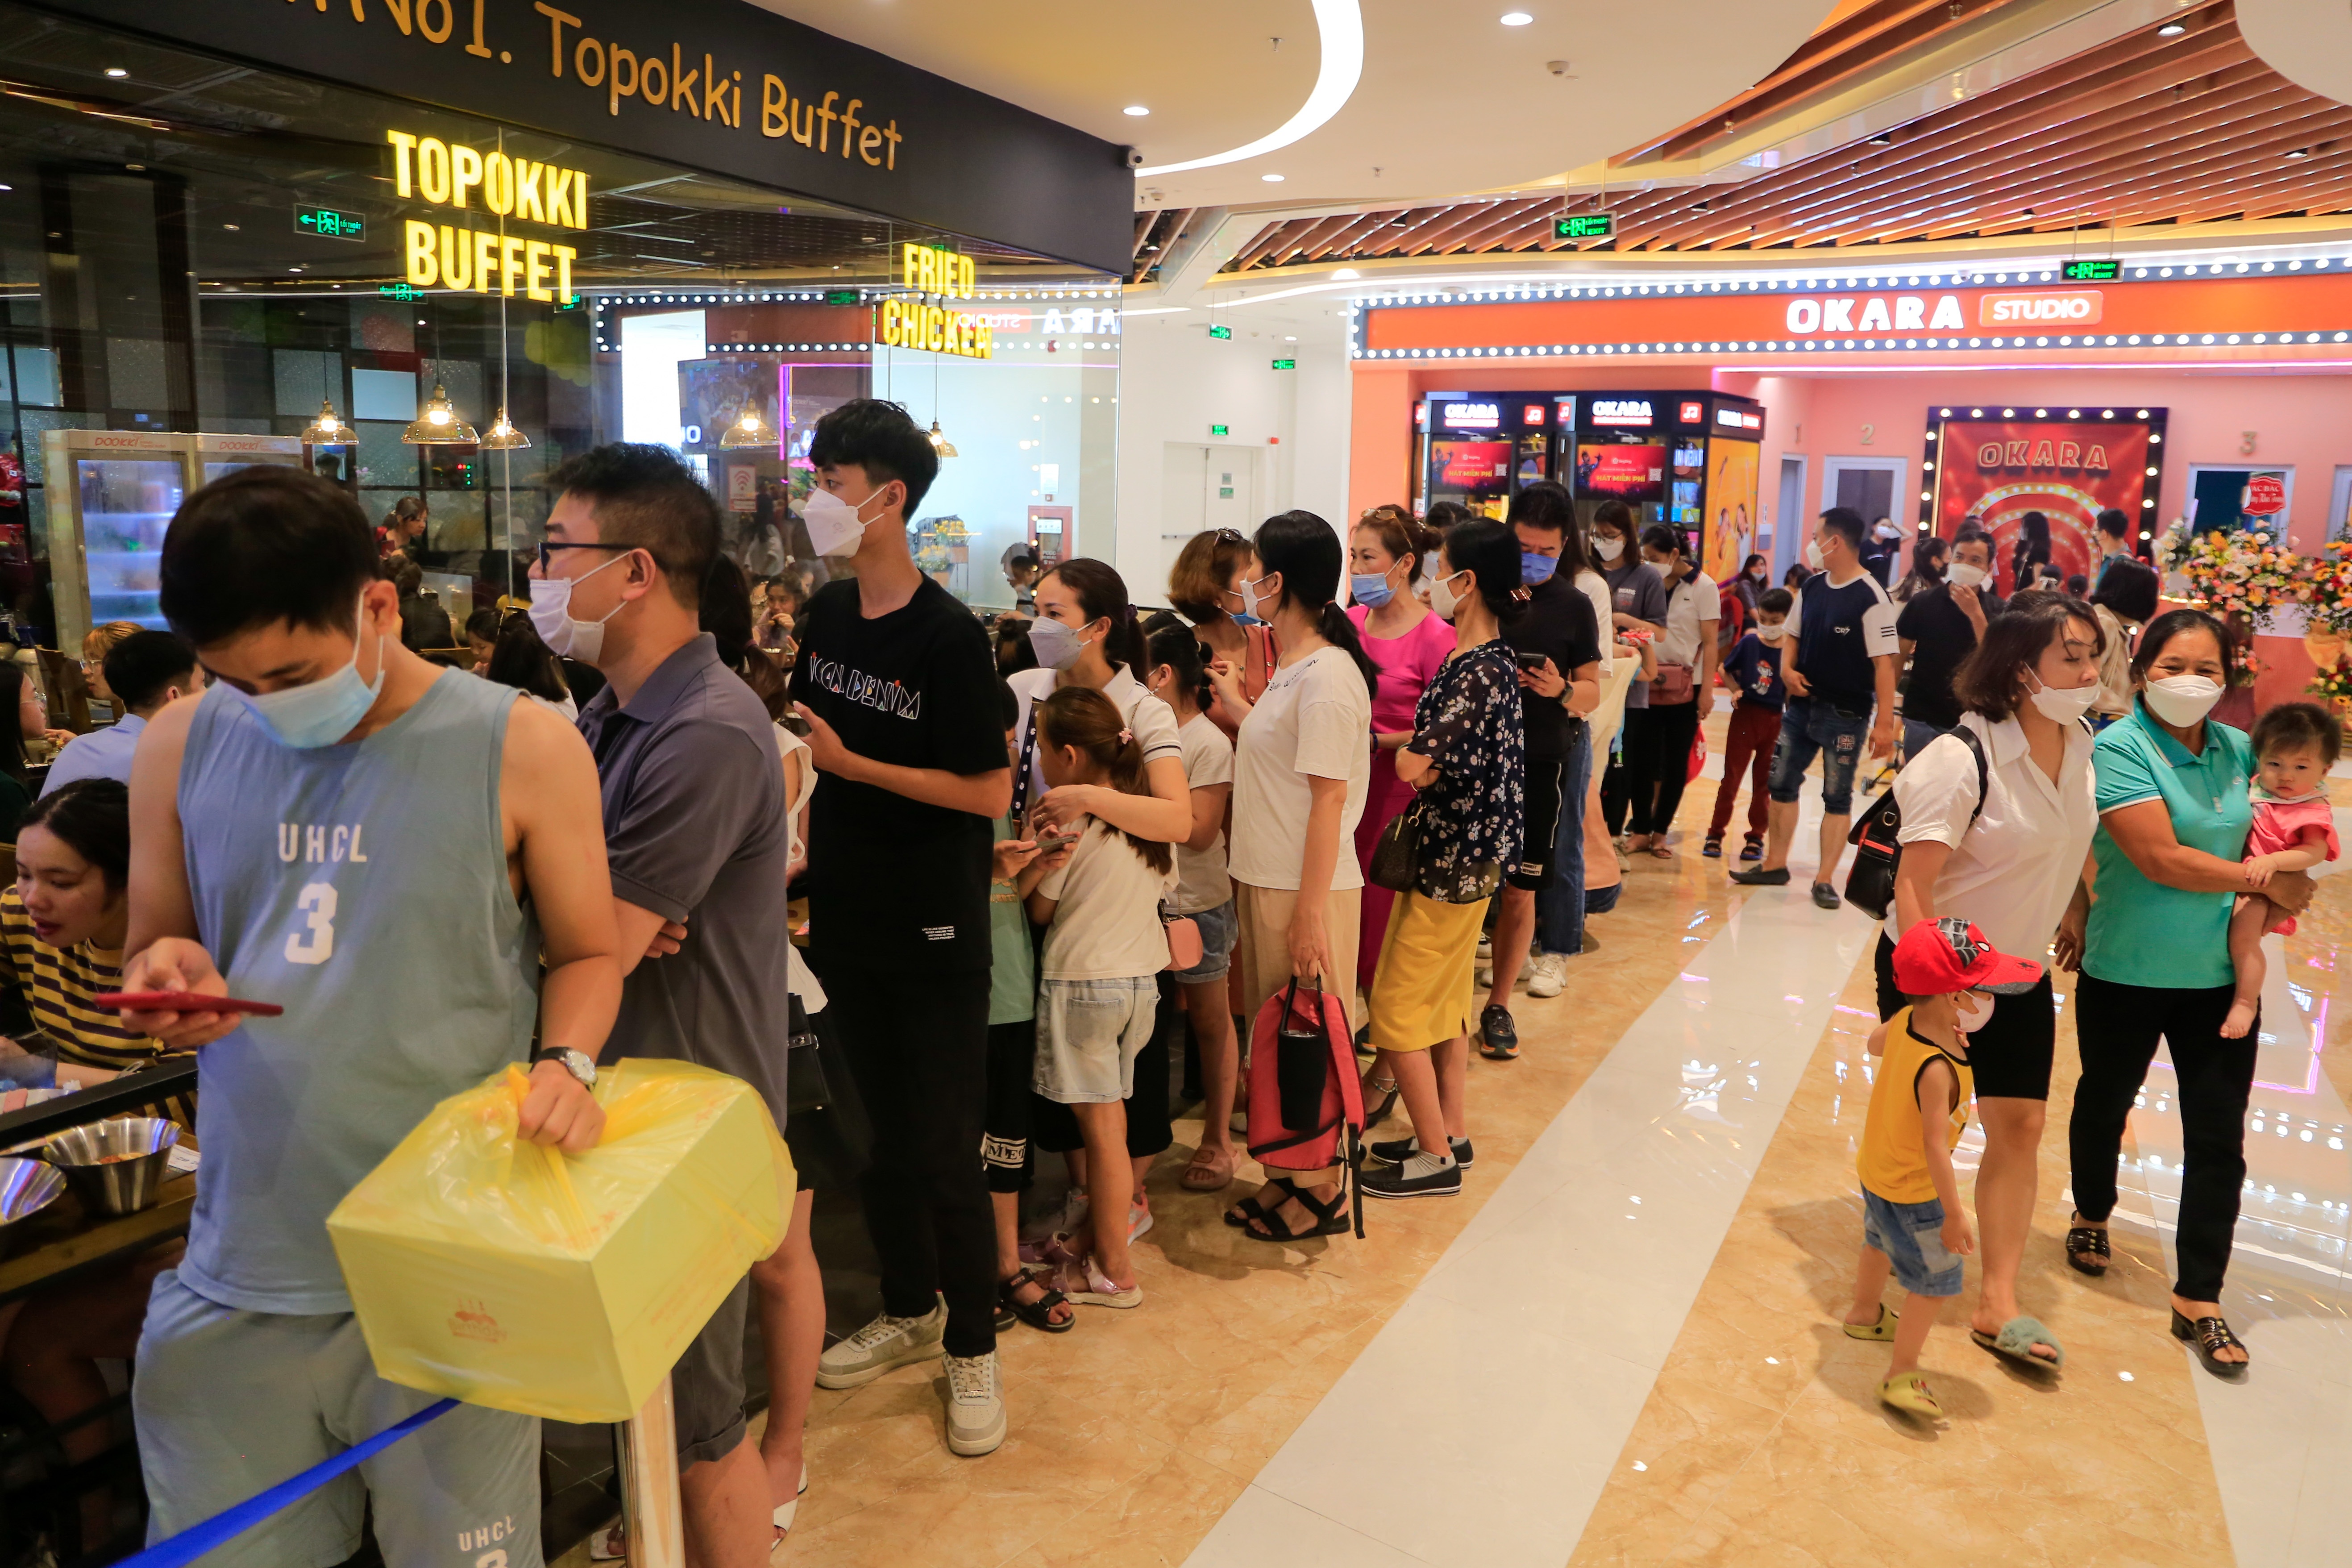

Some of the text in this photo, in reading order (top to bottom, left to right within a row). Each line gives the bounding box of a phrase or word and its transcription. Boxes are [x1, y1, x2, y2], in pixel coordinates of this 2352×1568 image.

[535, 1, 741, 128] Topokki
[762, 74, 902, 171] Buffet
[387, 129, 588, 230] TOPOKKI
[405, 219, 578, 304] BUFFET
[903, 242, 975, 300] FRIED
[883, 299, 992, 359] CHICKEN
[1786, 295, 2090, 333] OKARA STUDIO
[1445, 403, 1500, 419] OKARA
[1592, 401, 1653, 416] OKARA
[95, 437, 138, 447] DOOKKI
[1861, 424, 1874, 445] 2
[2240, 431, 2258, 453] 3
[1977, 440, 2109, 470] OKARA
[1835, 626, 1850, 636] CR7
[847, 670, 920, 720] DENIM
[278, 823, 368, 863] UHCL
[284, 882, 338, 965] 3
[458, 1515, 516, 1552] UHCL
